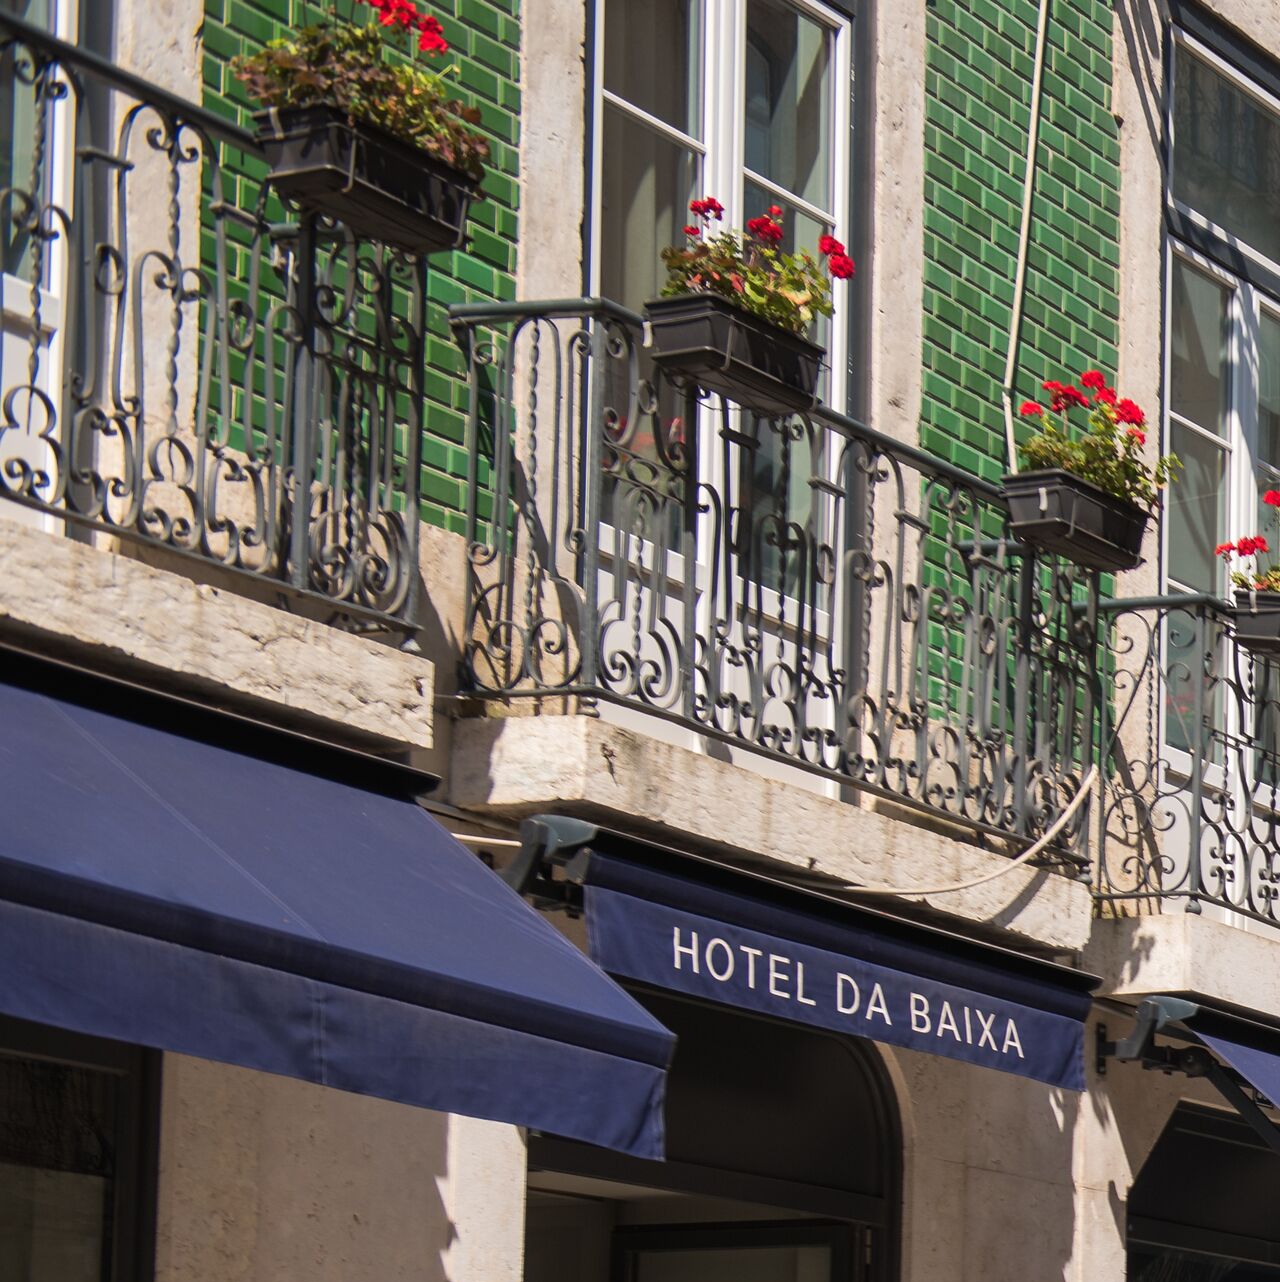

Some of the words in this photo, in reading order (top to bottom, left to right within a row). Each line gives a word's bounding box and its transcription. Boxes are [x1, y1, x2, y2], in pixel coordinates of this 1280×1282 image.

[673, 926, 817, 1006] HOTEL
[836, 972, 893, 1026] DA
[911, 993, 1025, 1058] BAIXA
